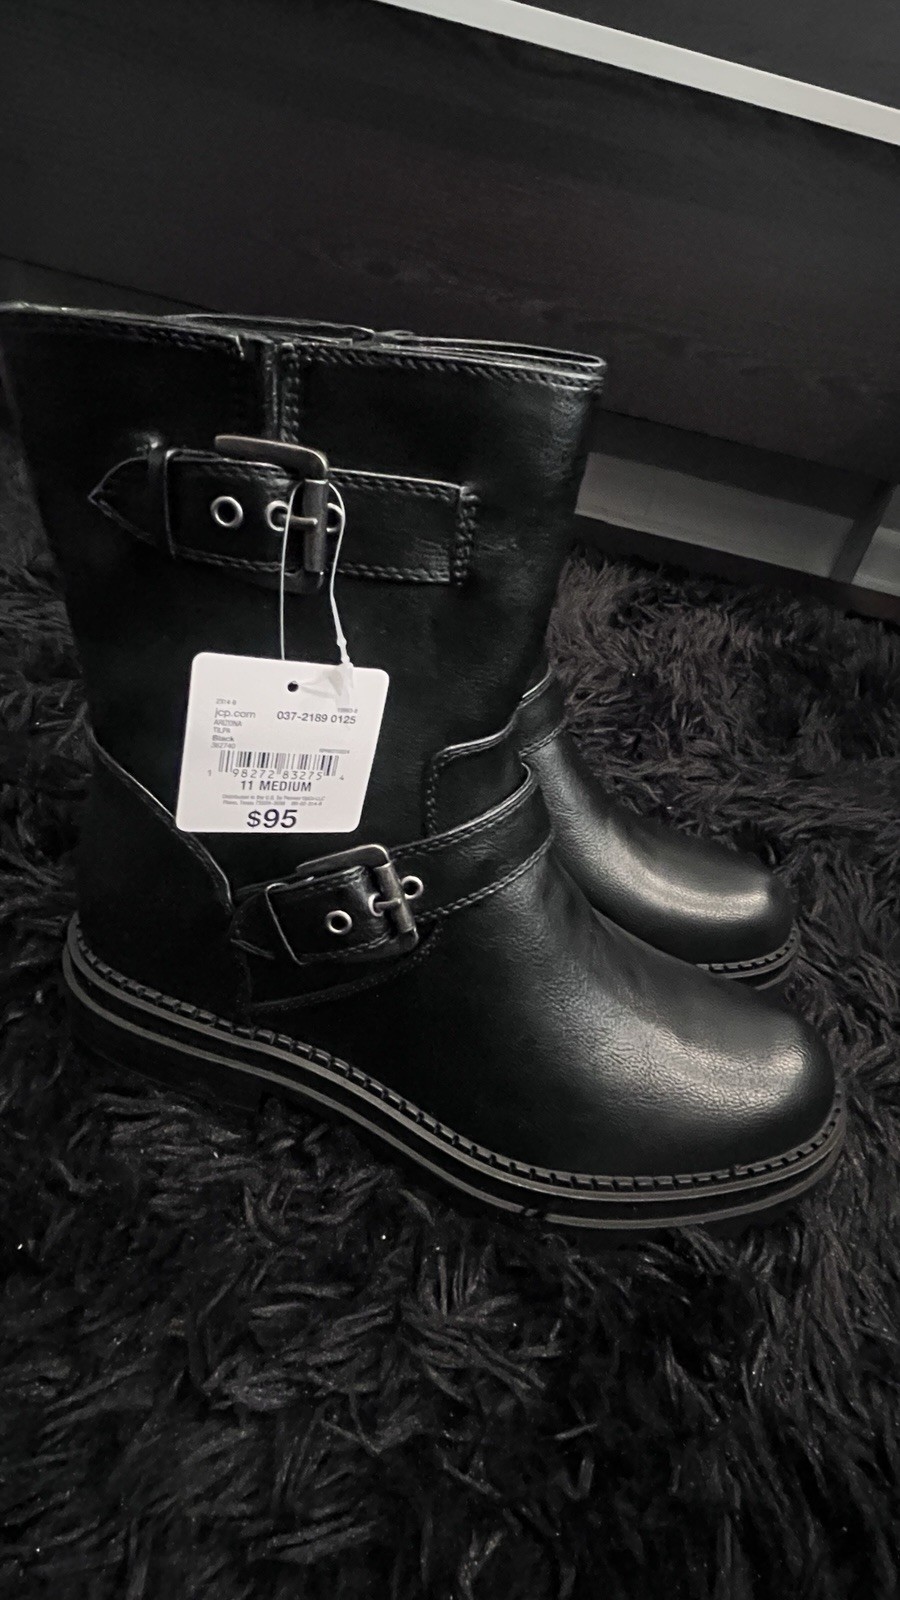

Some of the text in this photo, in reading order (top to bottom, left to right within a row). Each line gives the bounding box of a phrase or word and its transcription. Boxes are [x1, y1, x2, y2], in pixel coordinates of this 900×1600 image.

[214, 707, 256, 719] jcp.com
[276, 710, 328, 723] 037-2189
[330, 714, 357, 724] 0125
[213, 719, 242, 727] ARIZONA
[212, 734, 235, 742] Black
[207, 769, 212, 777] 1
[232, 768, 275, 779] 98272
[282, 771, 322, 781] 83275
[240, 780, 312, 792] 11 MEDIUM
[246, 808, 298, 828] $95
